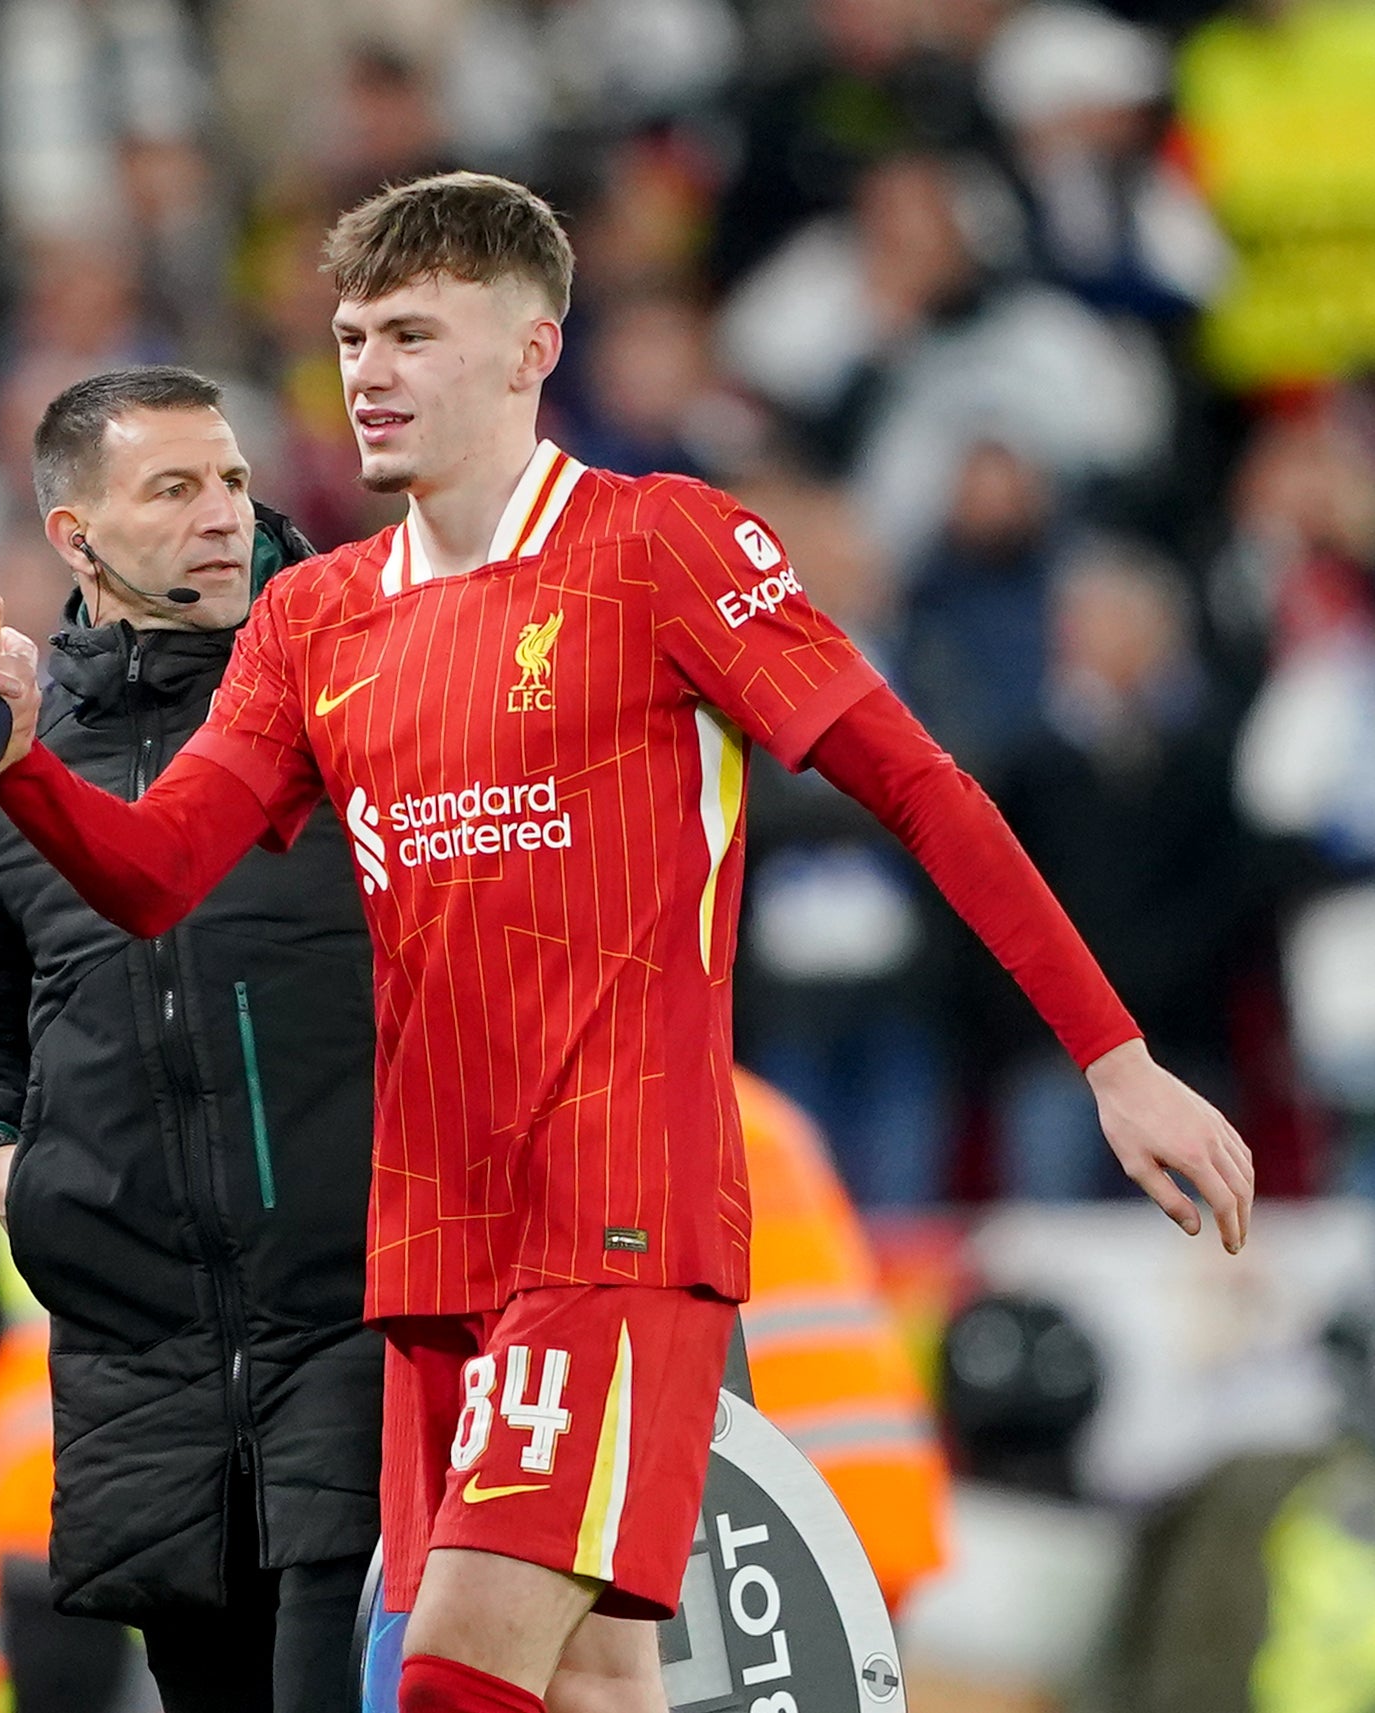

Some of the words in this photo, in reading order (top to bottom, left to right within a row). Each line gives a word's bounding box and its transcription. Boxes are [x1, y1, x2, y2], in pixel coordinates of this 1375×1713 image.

[390, 776, 556, 831] standard
[398, 812, 572, 867] chartered
[450, 1345, 572, 1475] 84
